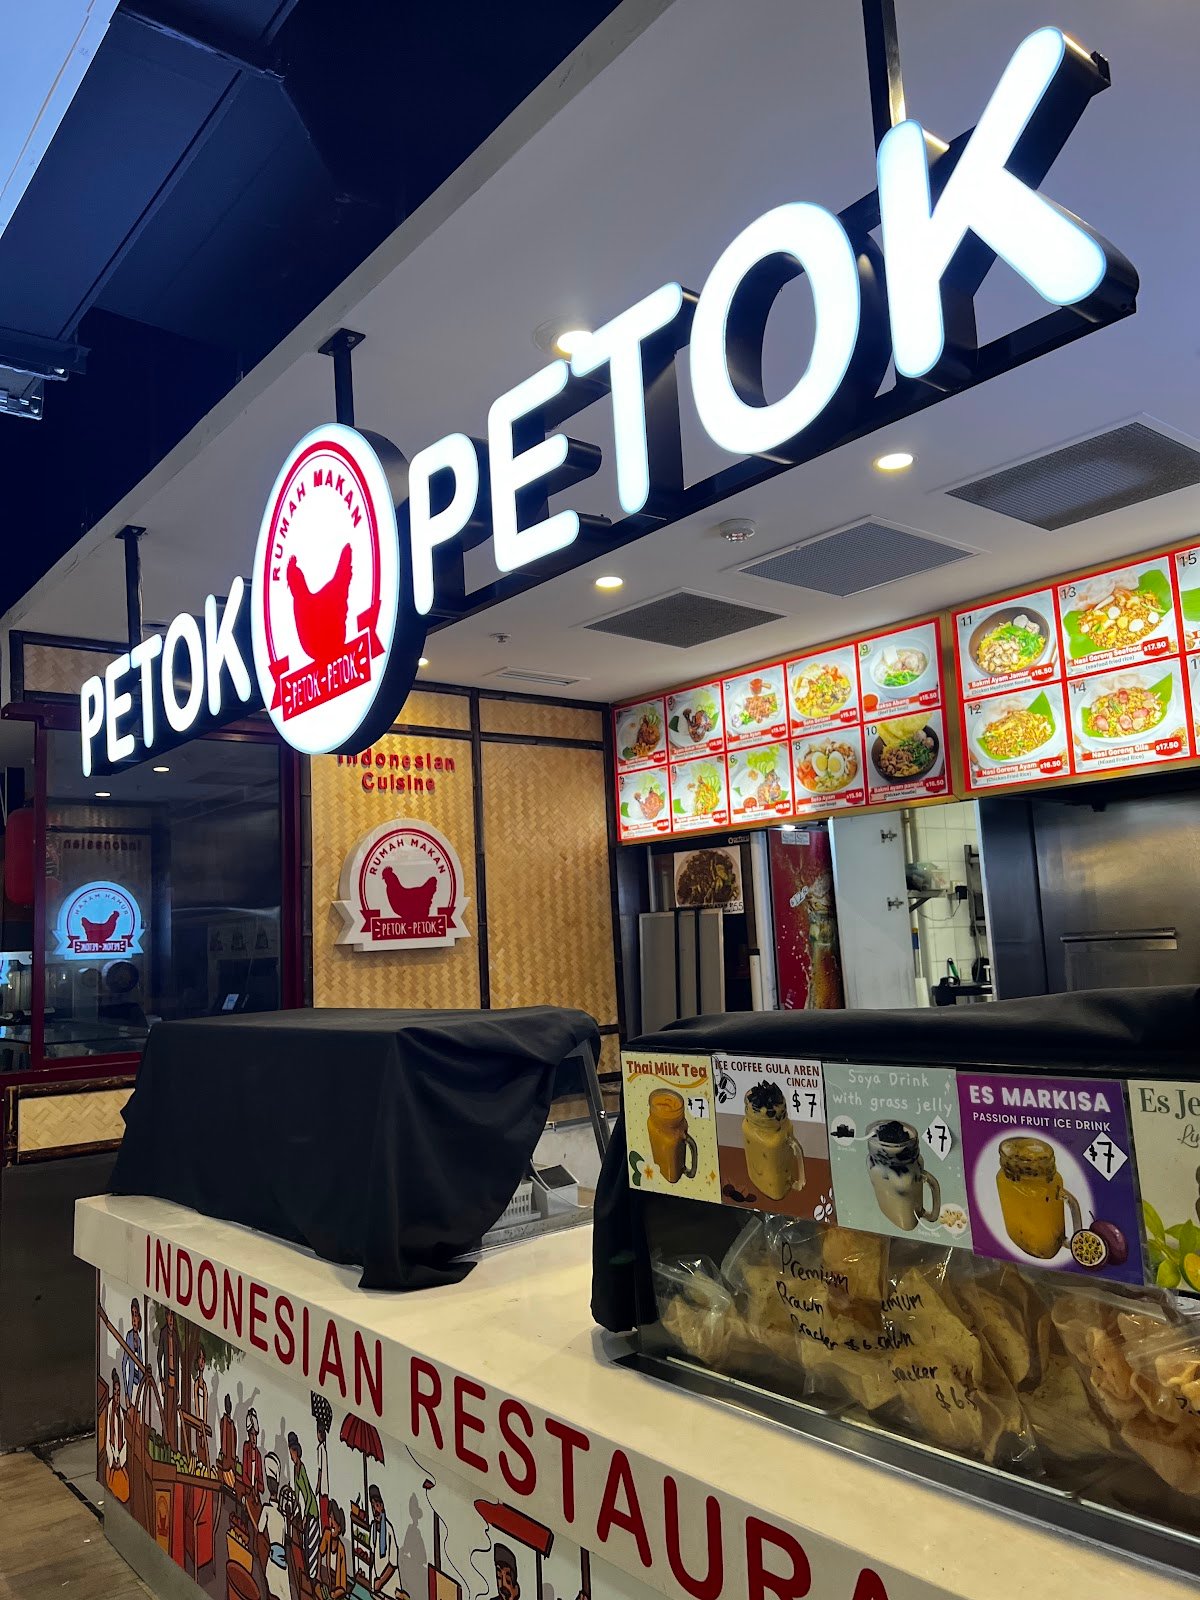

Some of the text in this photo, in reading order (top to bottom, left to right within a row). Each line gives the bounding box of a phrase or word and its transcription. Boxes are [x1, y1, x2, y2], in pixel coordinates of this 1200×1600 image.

[409, 26, 1106, 615] PETOK
[272, 469, 362, 581] RUMAH MAKAN
[1180, 553, 1197, 567] 15
[1062, 586, 1076, 599] 13
[961, 616, 973, 626] 11
[862, 644, 869, 653] 9
[1088, 651, 1113, 662] Goreng
[1114, 645, 1142, 656] Seafood
[1144, 641, 1166, 652] $17.50
[789, 663, 795, 672] 7
[1190, 659, 1200, 670] 1
[80, 576, 251, 777] PETOK
[972, 670, 1029, 688] Bakmi Ayam Jamur
[725, 680, 731, 690] 5
[1071, 682, 1087, 694] 14
[968, 704, 982, 715] 12
[866, 725, 877, 736] 10
[795, 741, 801, 751] 8
[1092, 751, 1107, 759] Nasi
[1108, 747, 1134, 757] Goreng
[1155, 741, 1179, 751] $17.50
[729, 754, 736, 764] 6
[982, 761, 1037, 776] Nasi Goreng Ayam
[362, 772, 435, 792] Cuisine
[369, 838, 446, 876] RUMAH MAKAN
[382, 921, 437, 936] PETOK-PETOK
[626, 1060, 708, 1079] Thai Milk Tea
[731, 1061, 763, 1073] COFFEE
[765, 1063, 790, 1075] GULA
[794, 1065, 820, 1077] AREN
[787, 1077, 818, 1088] CINCAU
[849, 1069, 929, 1089] Soya Drink
[832, 1091, 953, 1118] with grass jelly
[969, 1085, 1111, 1112] ES MARKISA
[1138, 1087, 1170, 1114] Es
[687, 1097, 705, 1118] $7
[973, 1112, 1111, 1132] PASSION FRUIT ICE DRINK
[925, 1125, 948, 1152] $7
[1088, 1141, 1115, 1174] $7
[781, 1241, 850, 1295] Premium
[776, 1280, 825, 1318] Prawn
[146, 1234, 889, 1600] INDONESIAN RESTAUR
